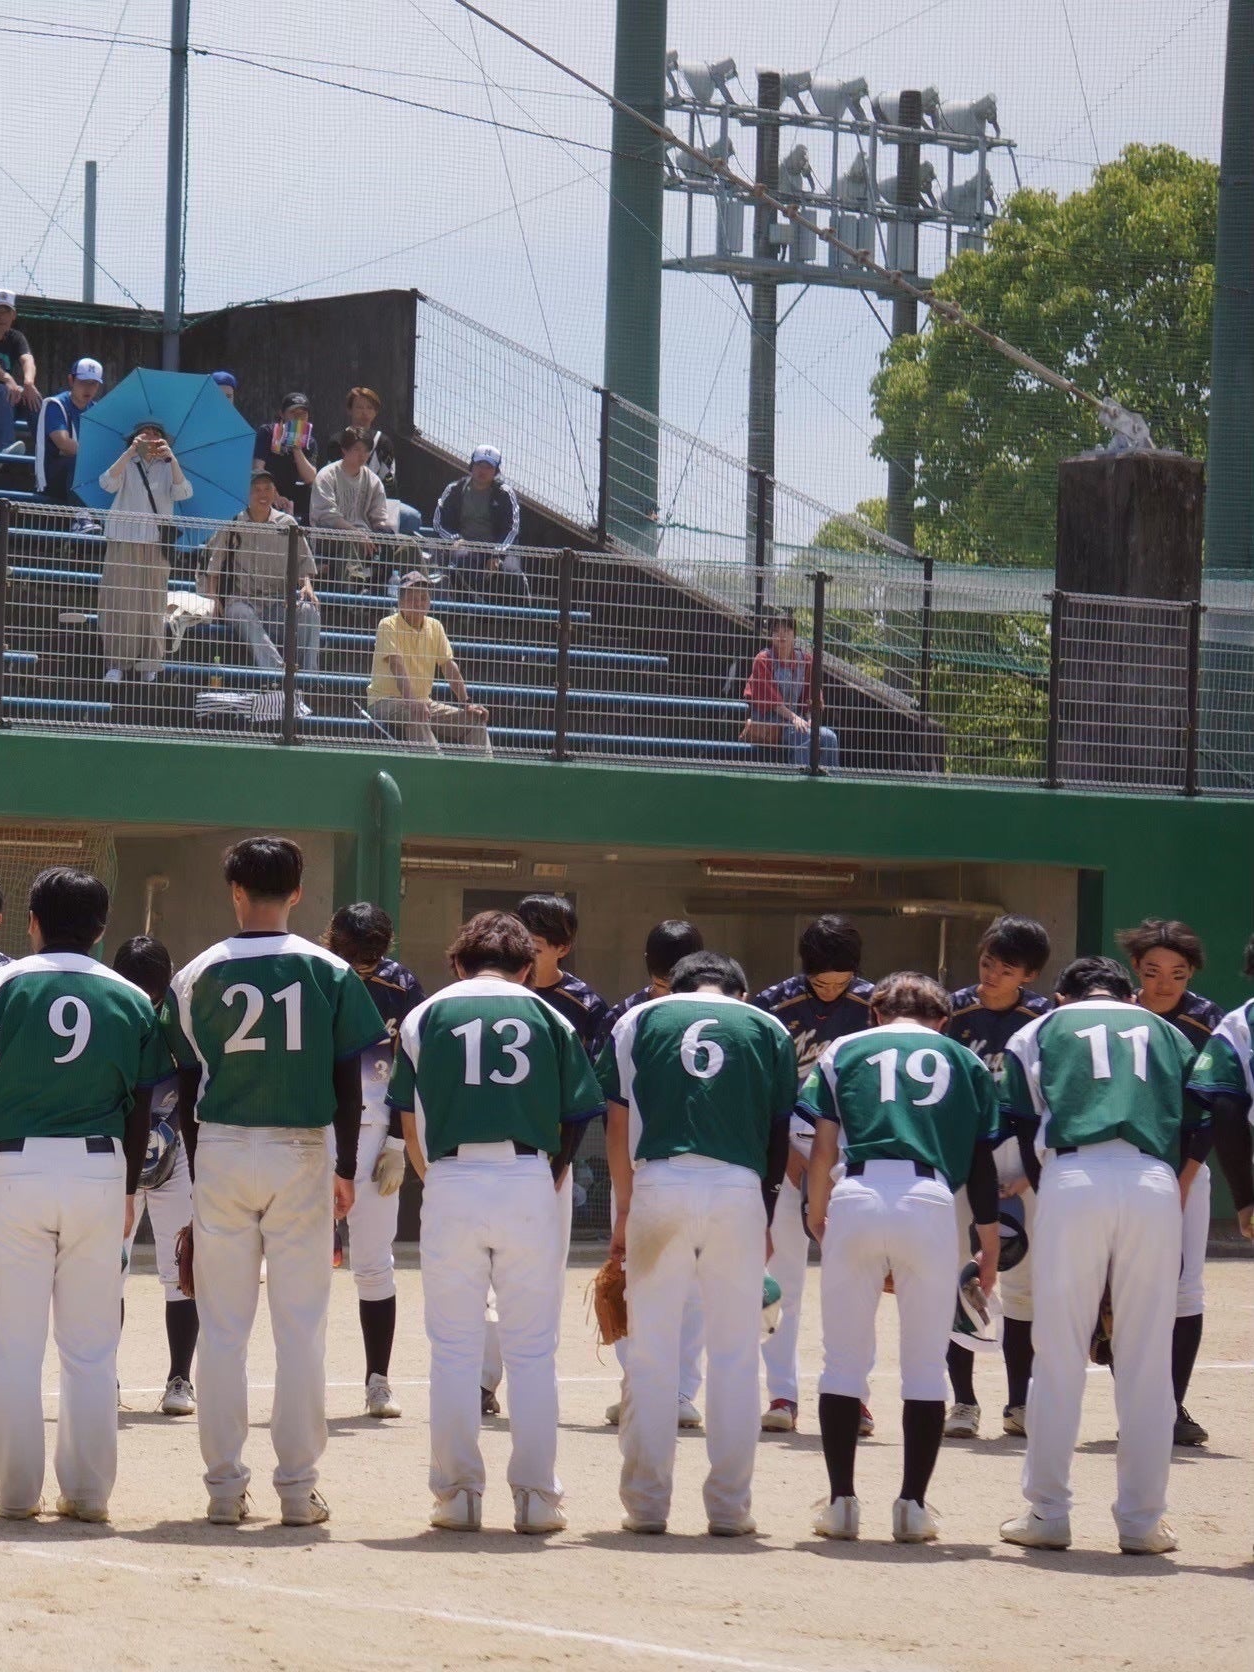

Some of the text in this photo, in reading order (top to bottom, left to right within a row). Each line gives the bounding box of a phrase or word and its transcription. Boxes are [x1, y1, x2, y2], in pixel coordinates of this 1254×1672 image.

[48, 996, 91, 1064] 9
[221, 982, 302, 1053] 21
[371, 1060, 391, 1082] 3
[450, 1017, 531, 1085] 13
[680, 1018, 725, 1079] 6
[865, 1047, 951, 1106] 19
[1074, 1024, 1149, 1082] 11
